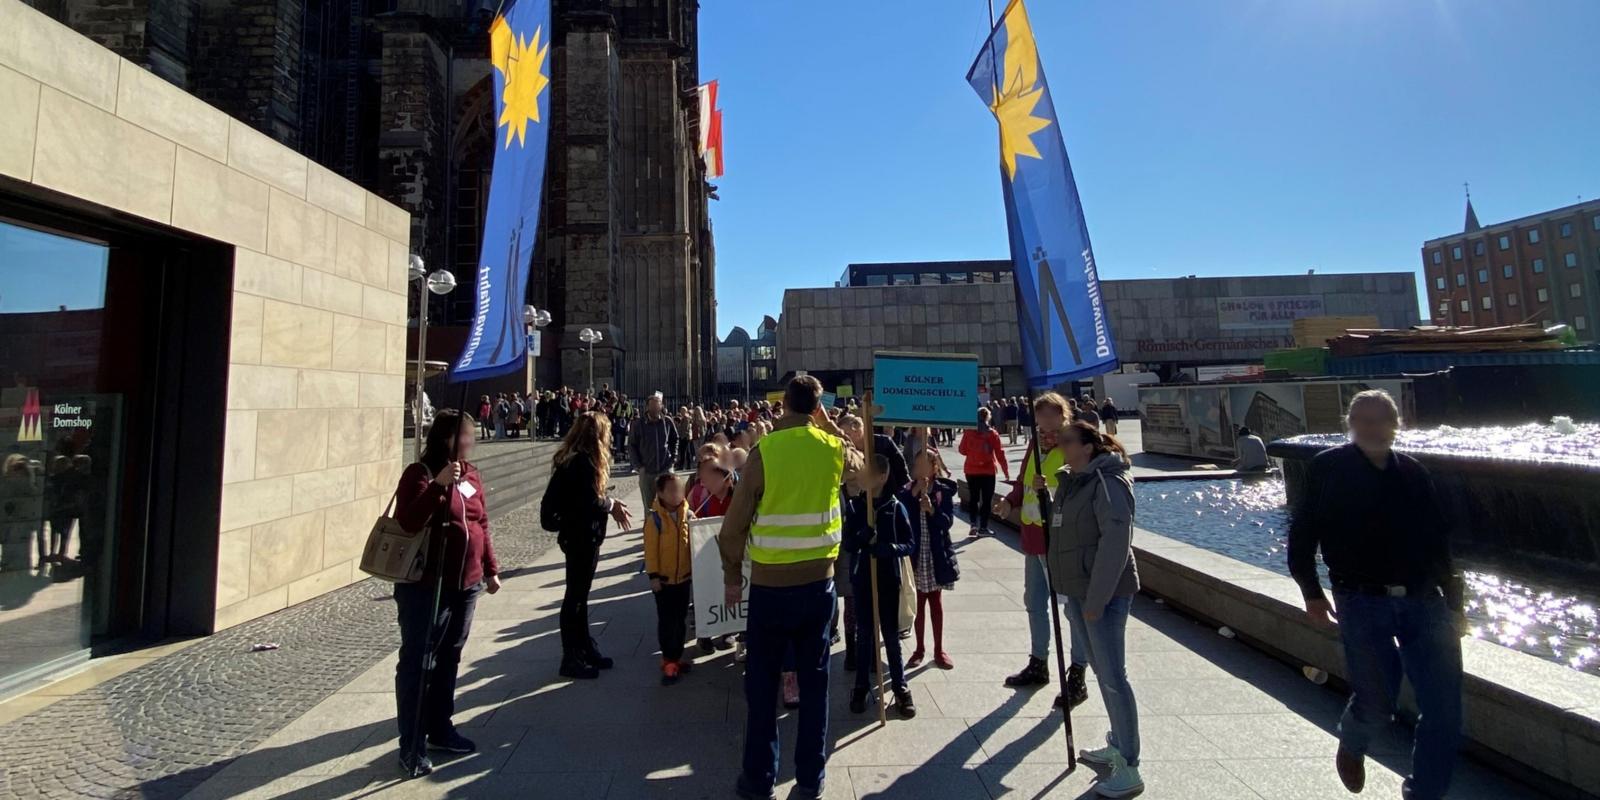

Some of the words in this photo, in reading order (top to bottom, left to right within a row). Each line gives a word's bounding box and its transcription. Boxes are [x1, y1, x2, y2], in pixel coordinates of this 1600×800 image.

[1082, 248, 1110, 358] Domwallfahrt
[904, 375, 944, 384] KÖLNER
[882, 387, 967, 397] DOMSINGSCHULE
[54, 403, 82, 415] Kölner
[912, 403, 935, 412] KÖLN
[53, 416, 92, 430] Domshop
